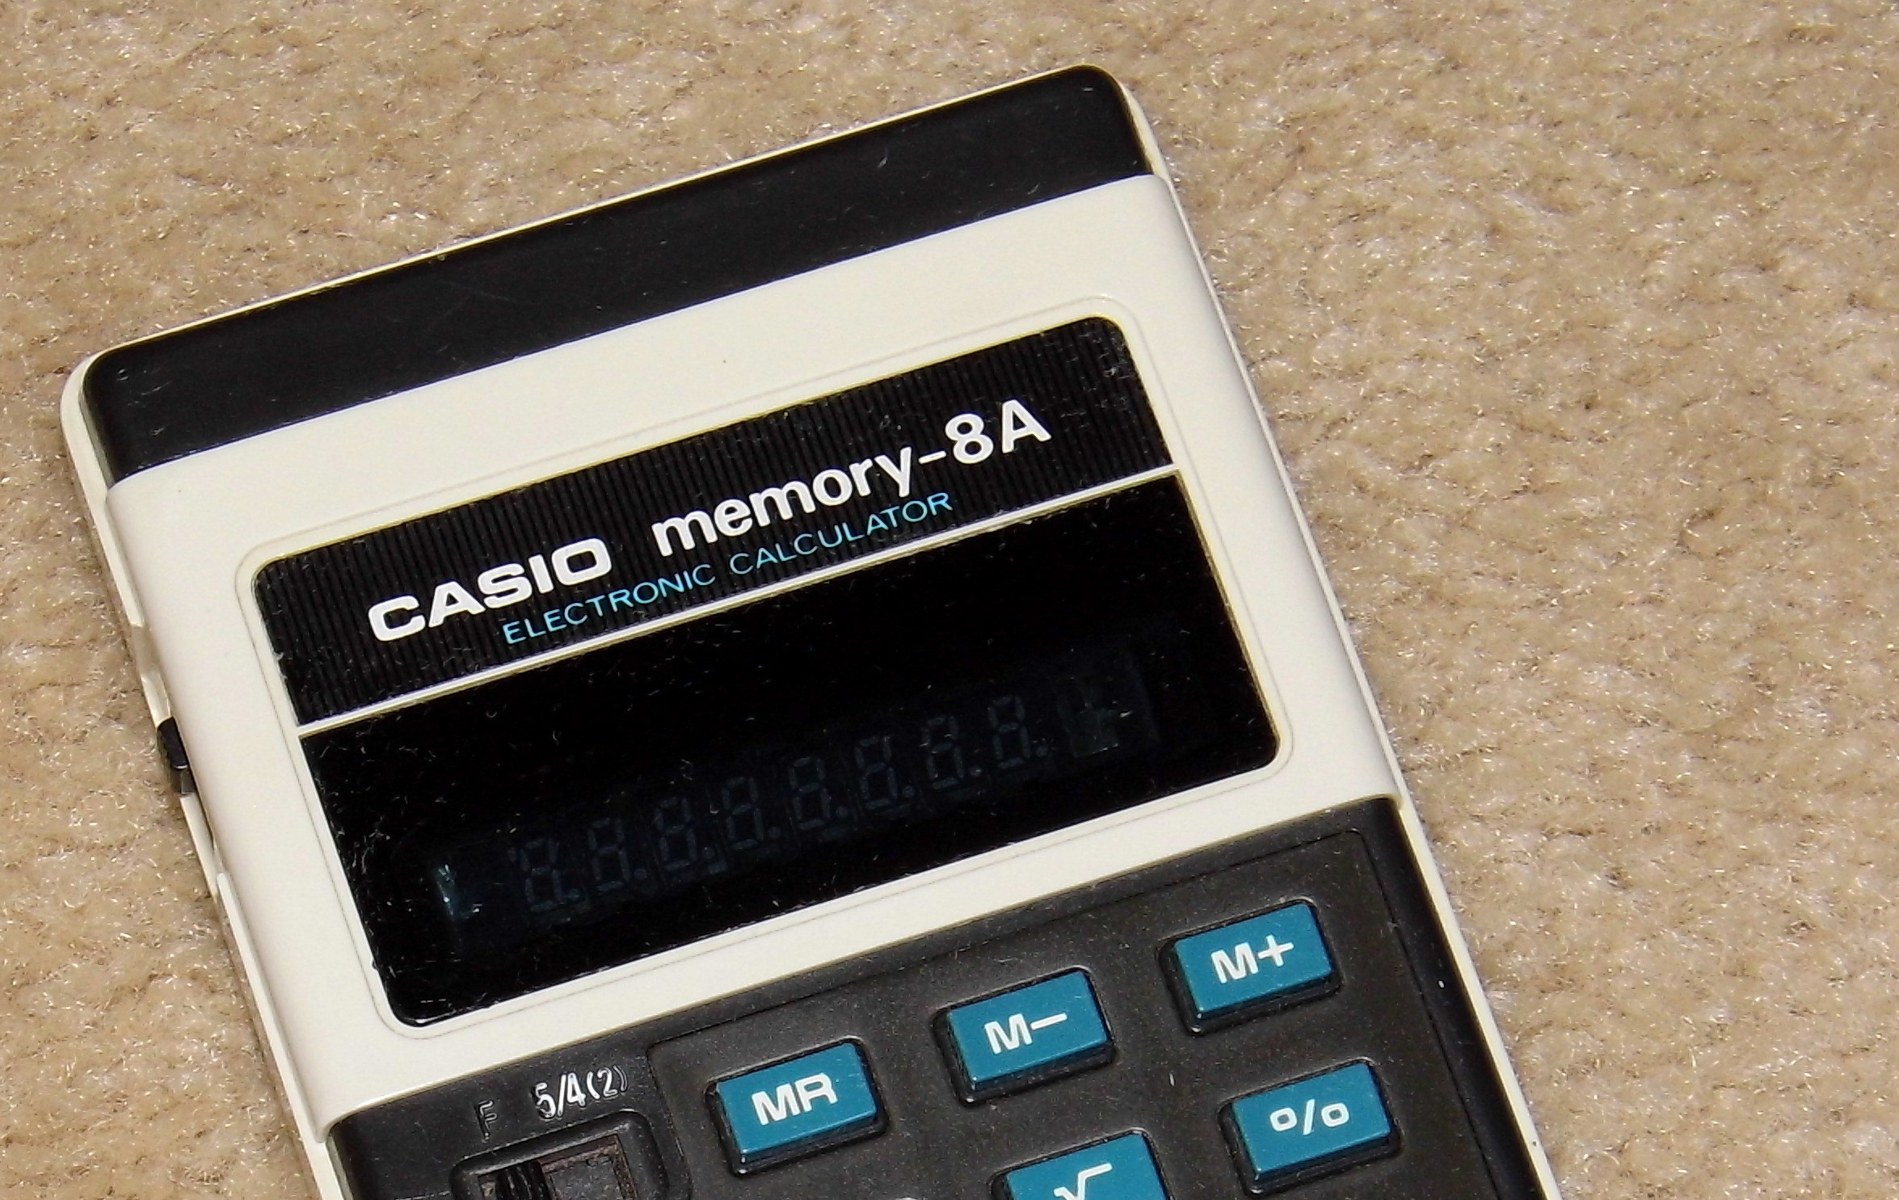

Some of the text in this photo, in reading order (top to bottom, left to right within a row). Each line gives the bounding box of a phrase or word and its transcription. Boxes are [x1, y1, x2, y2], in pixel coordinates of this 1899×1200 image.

[367, 399, 1052, 642] CASIO memory-8A
[502, 491, 954, 646] ELECTRONIC CALCULATOR
[1210, 935, 1294, 984] M+
[475, 1065, 628, 1142] F 5/4(2)
[752, 1072, 838, 1126] MR
[1269, 1099, 1350, 1135] %
